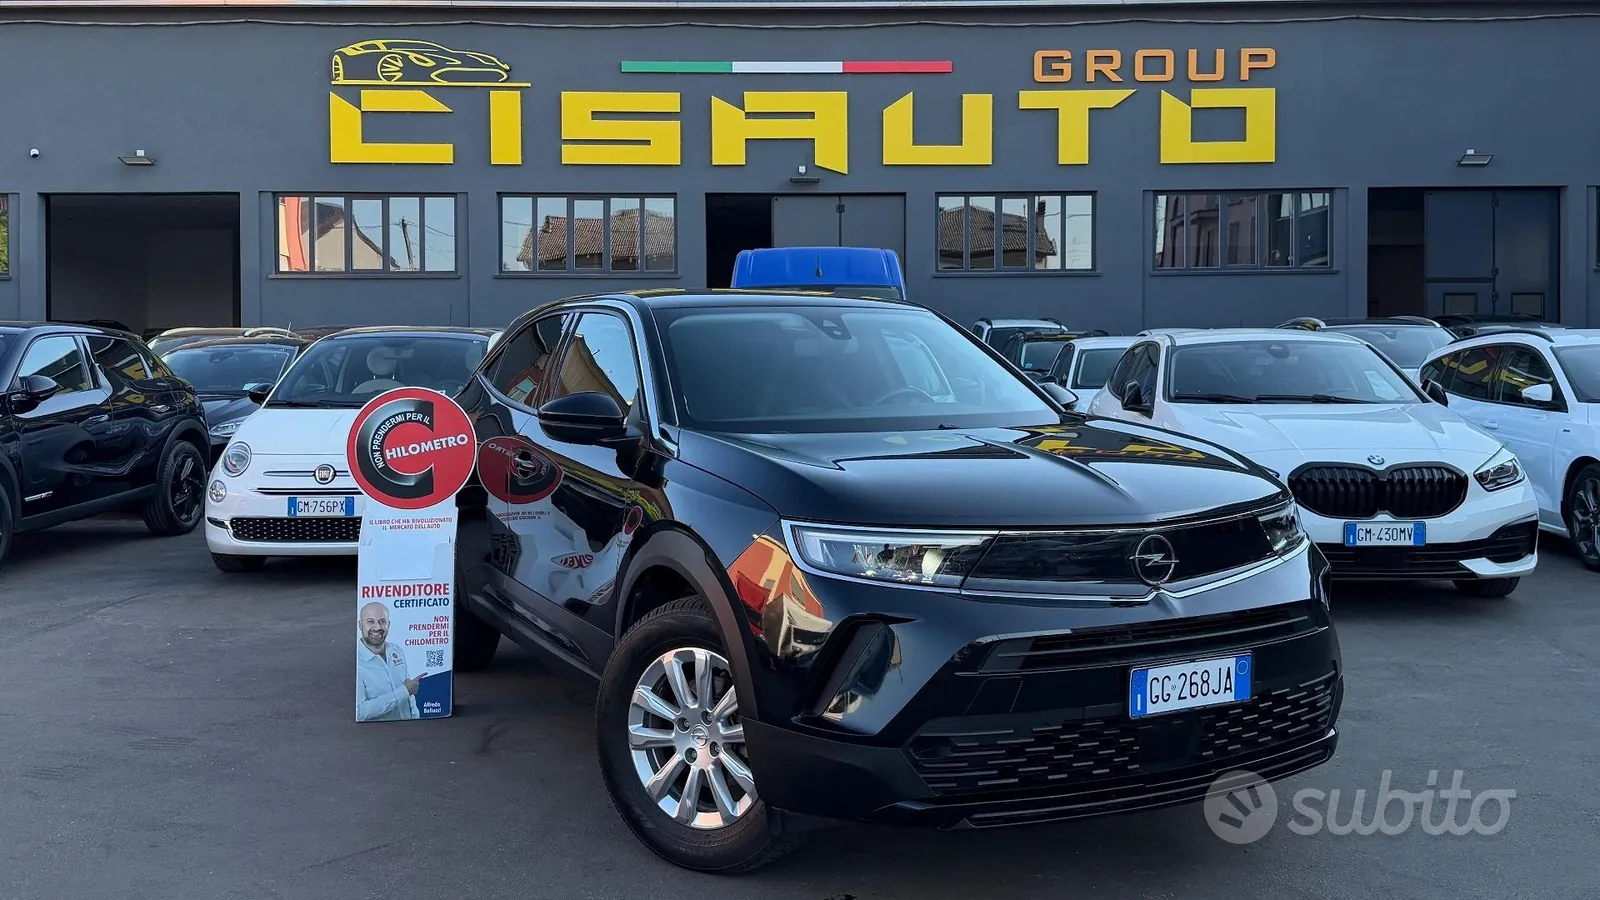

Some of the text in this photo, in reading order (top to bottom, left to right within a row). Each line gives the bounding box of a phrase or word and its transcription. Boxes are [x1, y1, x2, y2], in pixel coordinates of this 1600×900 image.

[1033, 48, 1276, 83] GROUP
[330, 88, 1275, 175] CISAUTO
[372, 412, 431, 469] NON PRENDERMI PER IL
[362, 583, 450, 598] RIVENDITORE
[393, 597, 450, 608] CERTIFICATO
[433, 615, 449, 623] NON
[408, 623, 449, 631] PRENDERMI
[404, 637, 449, 646] CHILOMETRO
